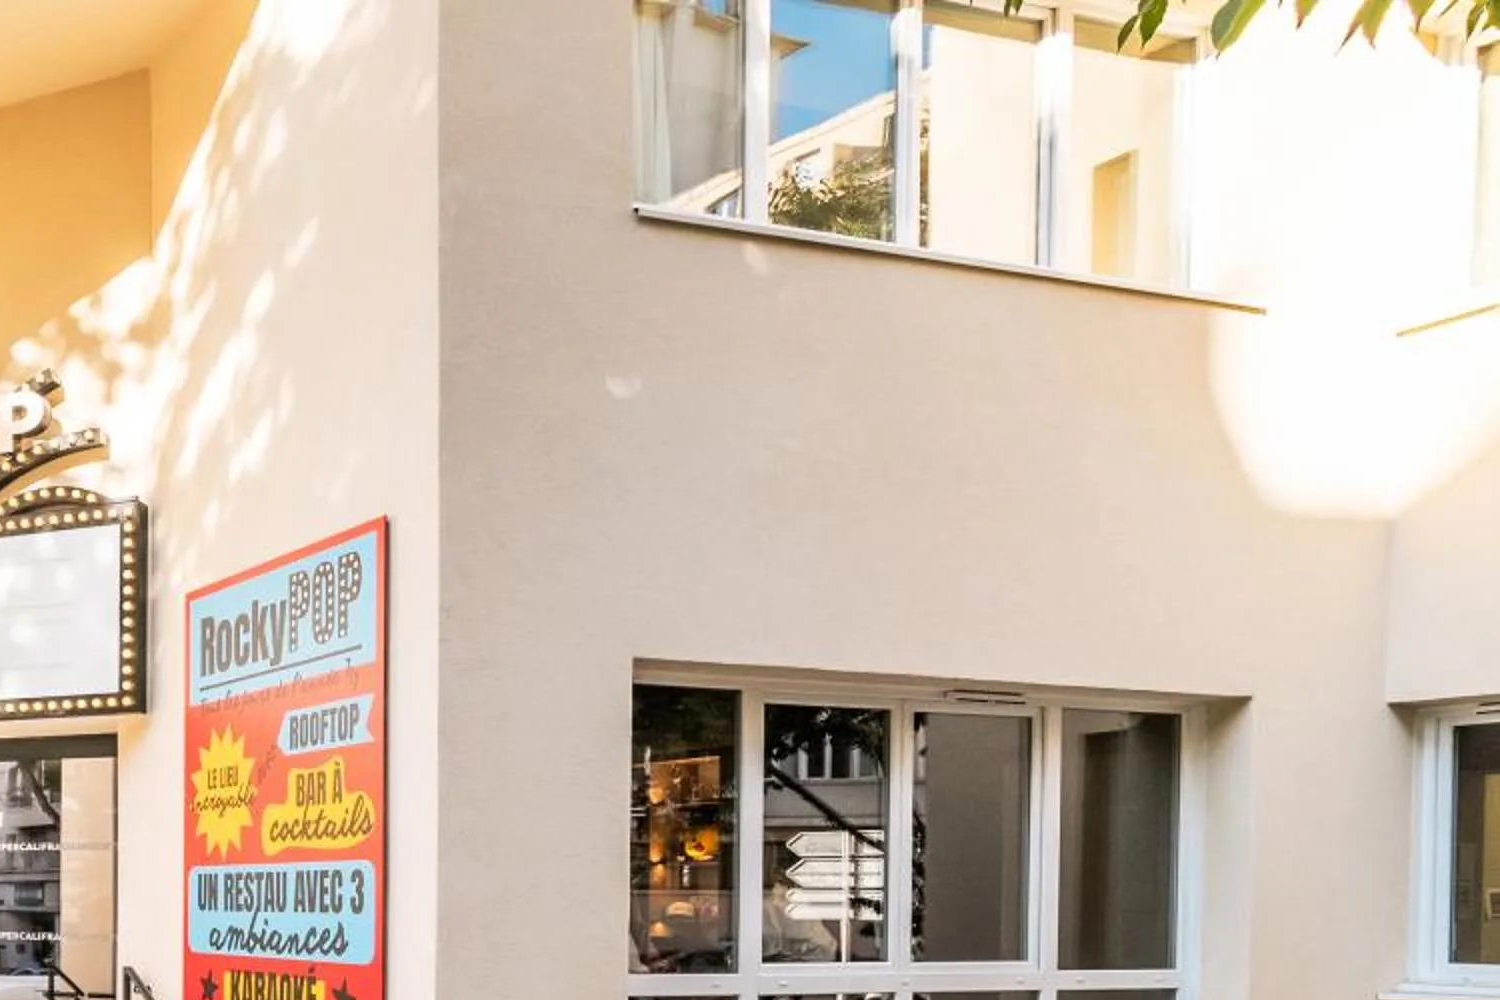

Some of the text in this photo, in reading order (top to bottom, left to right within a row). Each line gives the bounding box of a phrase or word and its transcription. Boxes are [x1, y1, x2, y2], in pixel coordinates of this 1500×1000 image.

[288, 703, 360, 750] ROOFTOP
[207, 767, 218, 790] LE
[219, 765, 239, 788] LIEU
[296, 761, 343, 807] BAR À
[269, 794, 373, 843] cocktails
[198, 868, 365, 914] UN RESTAU AVEC 3
[208, 908, 349, 956] ambiances
